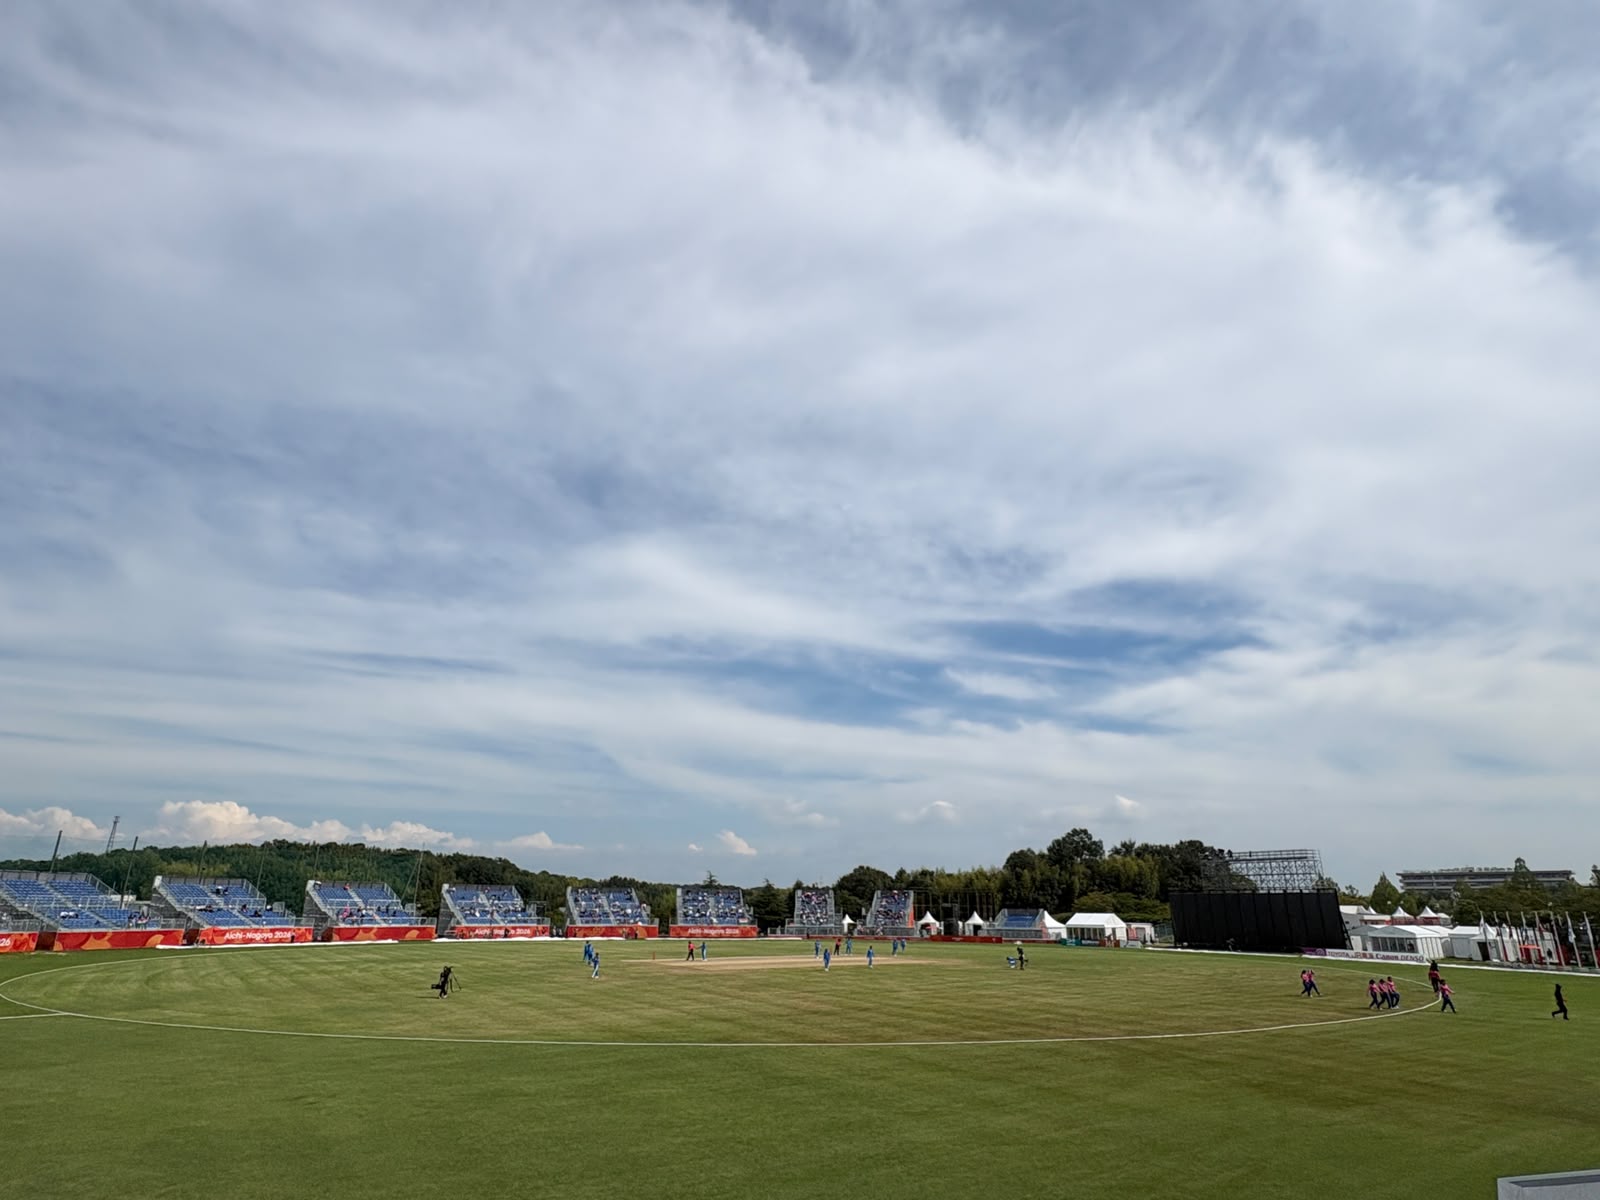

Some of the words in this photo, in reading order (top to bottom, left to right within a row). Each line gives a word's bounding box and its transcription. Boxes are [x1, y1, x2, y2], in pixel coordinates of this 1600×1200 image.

[224, 931, 273, 940] Aichi-Nagoya
[1376, 953, 1398, 961] Canon
[1400, 954, 1425, 962] DENSO
